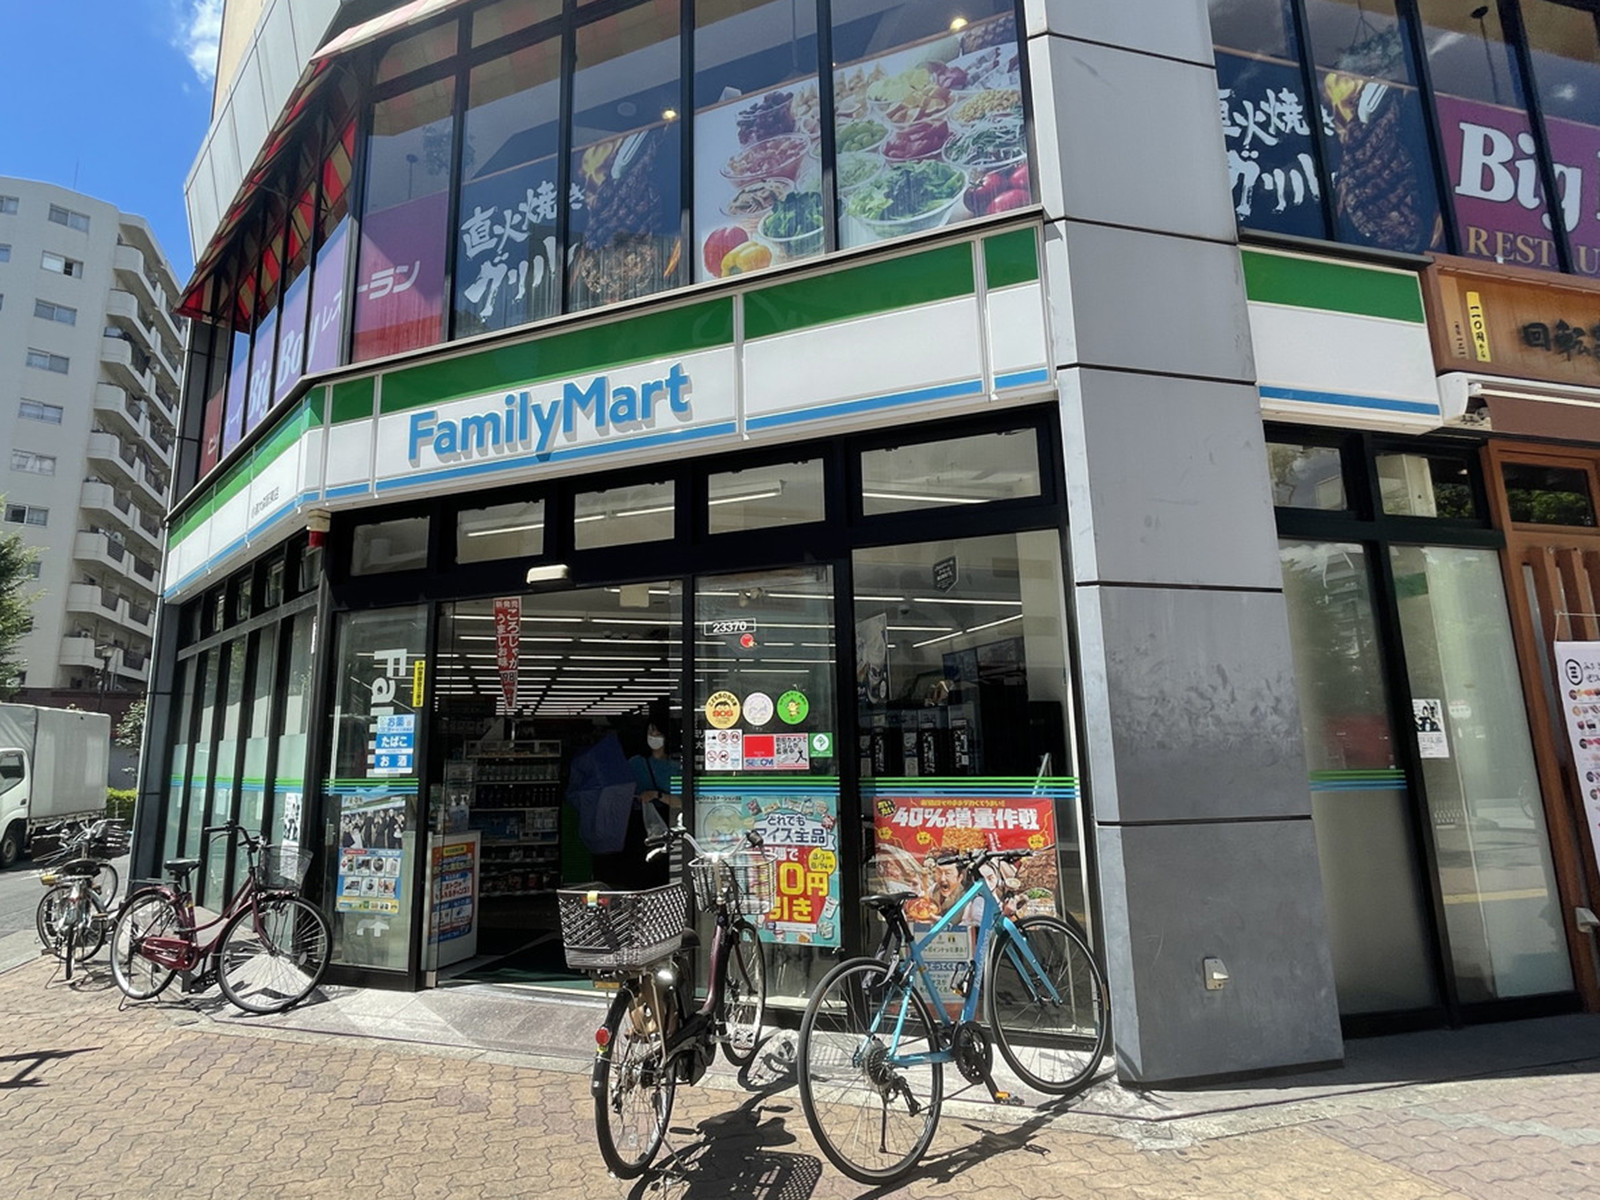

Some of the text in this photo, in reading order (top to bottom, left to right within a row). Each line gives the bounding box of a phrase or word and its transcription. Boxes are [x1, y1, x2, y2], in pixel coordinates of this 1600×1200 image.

[1466, 226, 1600, 275] RESTU
[408, 362, 690, 468] FamilyMart
[713, 621, 747, 633] 23370
[767, 815, 806, 826] どれでも
[892, 807, 1040, 830] 40%増量作戦
[779, 862, 829, 897] 0円
